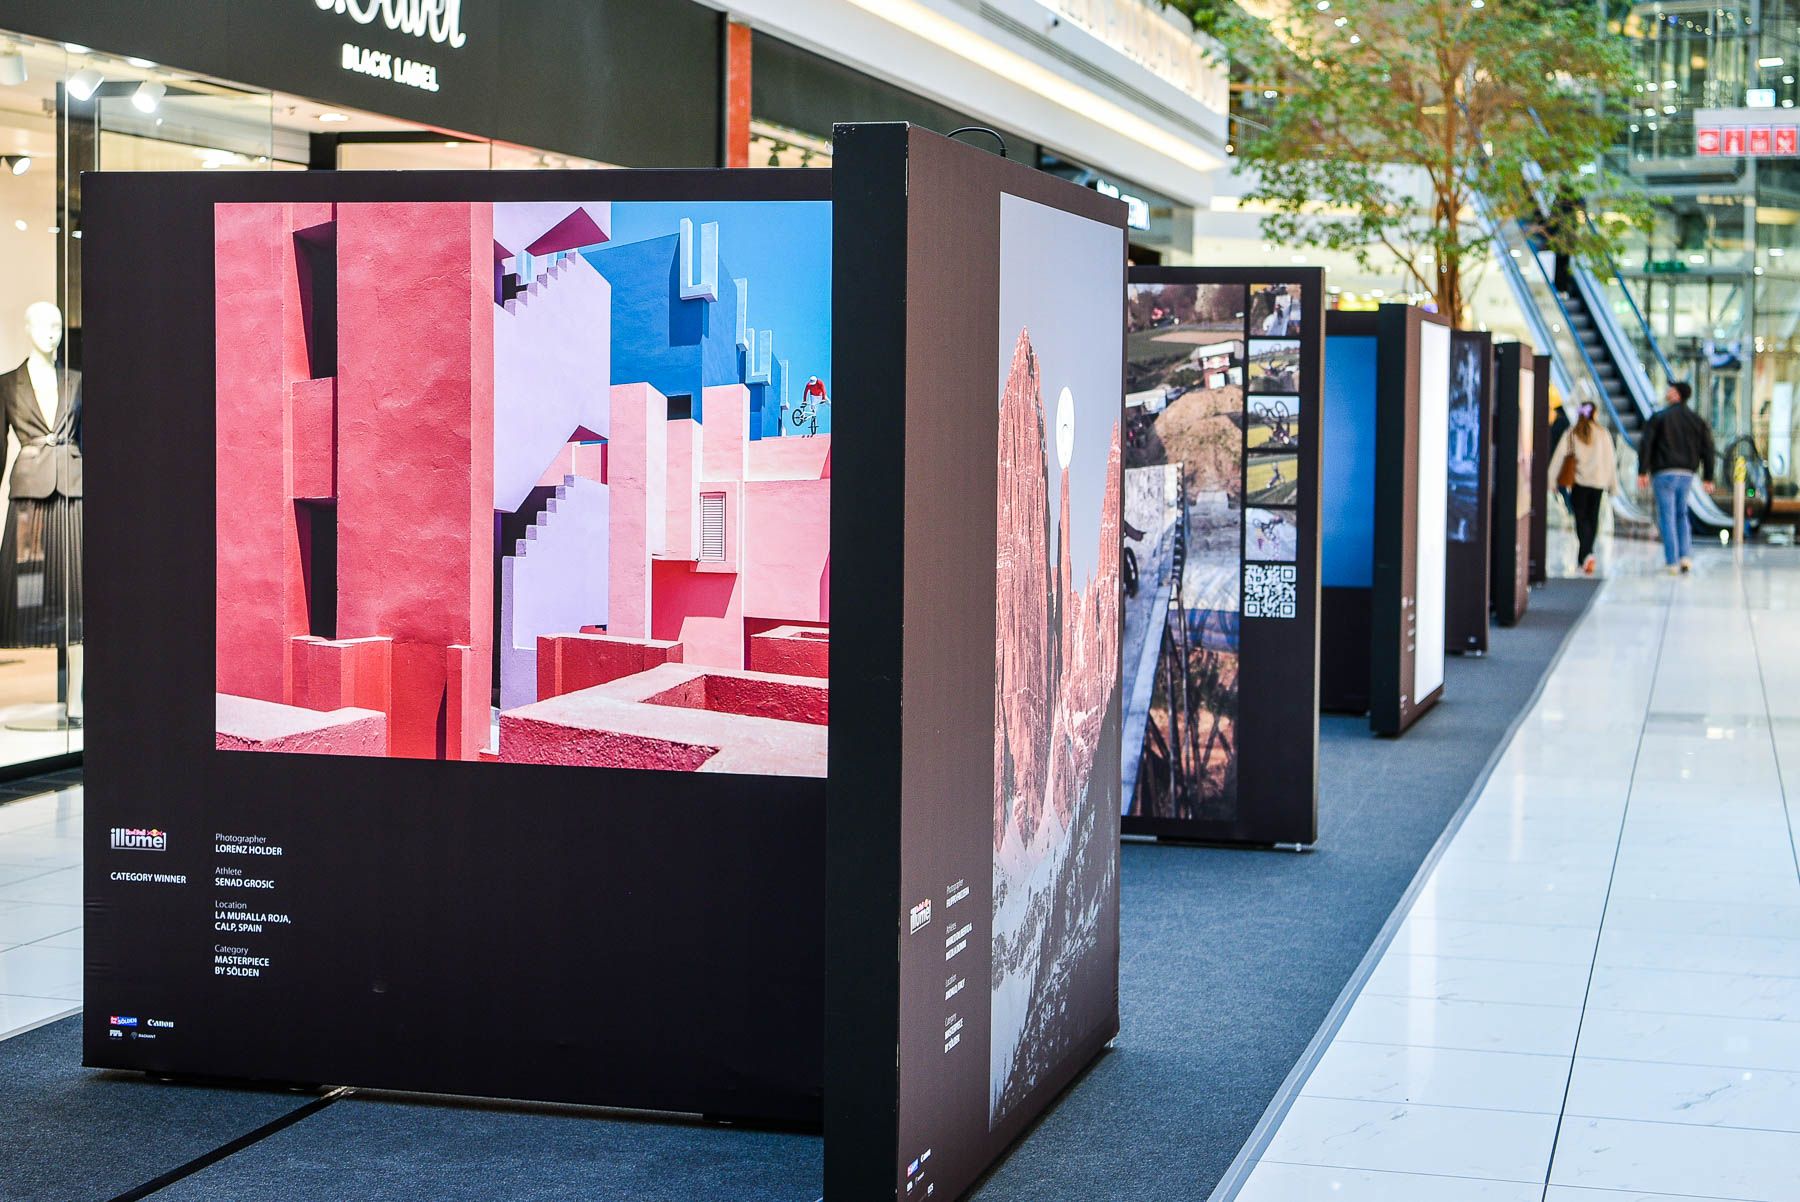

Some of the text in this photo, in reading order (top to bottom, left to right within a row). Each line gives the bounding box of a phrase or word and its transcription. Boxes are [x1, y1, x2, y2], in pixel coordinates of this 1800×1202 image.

[342, 43, 440, 92] BLACK LABEL
[110, 827, 166, 851] illume
[215, 833, 267, 845] Photographer
[215, 844, 283, 856] LORENZ HOLDER
[215, 866, 243, 876] Athlete
[110, 871, 187, 884] CATEGORY WINNER
[215, 877, 275, 889] SENAD GROSIC
[215, 900, 247, 909] Location
[215, 911, 292, 924] LA MURALLA ROJA,
[214, 922, 262, 933] CALP, SPAIN
[214, 944, 249, 955] Category
[214, 955, 270, 967] MASTERPIECE
[214, 965, 260, 977] BY SÖLDEN
[147, 1018, 174, 1029] Canon
